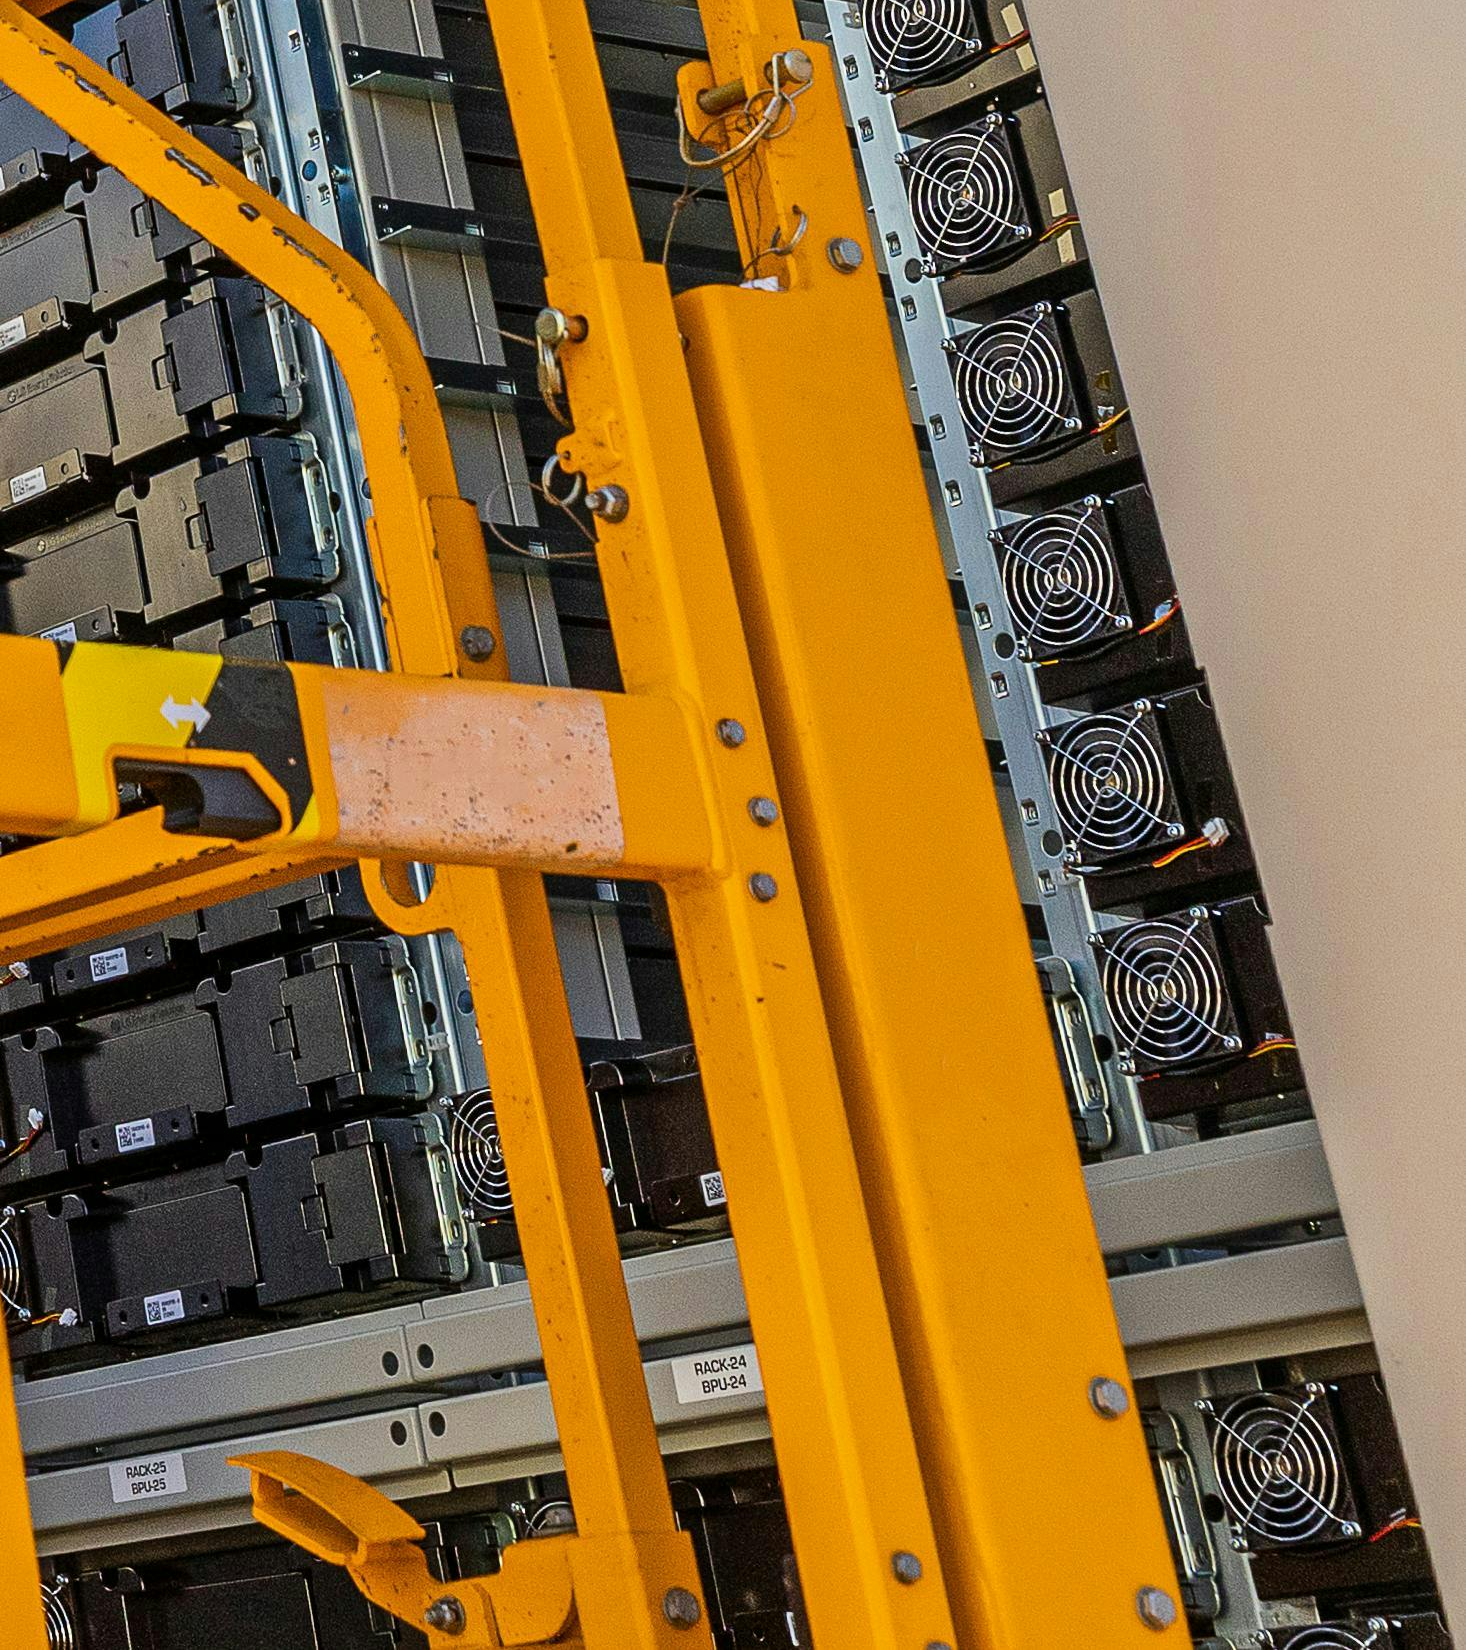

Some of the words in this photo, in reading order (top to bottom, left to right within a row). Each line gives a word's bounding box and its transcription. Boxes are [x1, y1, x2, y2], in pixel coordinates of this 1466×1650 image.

[694, 1354, 747, 1376] RACK-24
[701, 1374, 747, 1394] BPU-24
[125, 1461, 167, 1479] RACK-25
[131, 1478, 167, 1494] BPU-25
